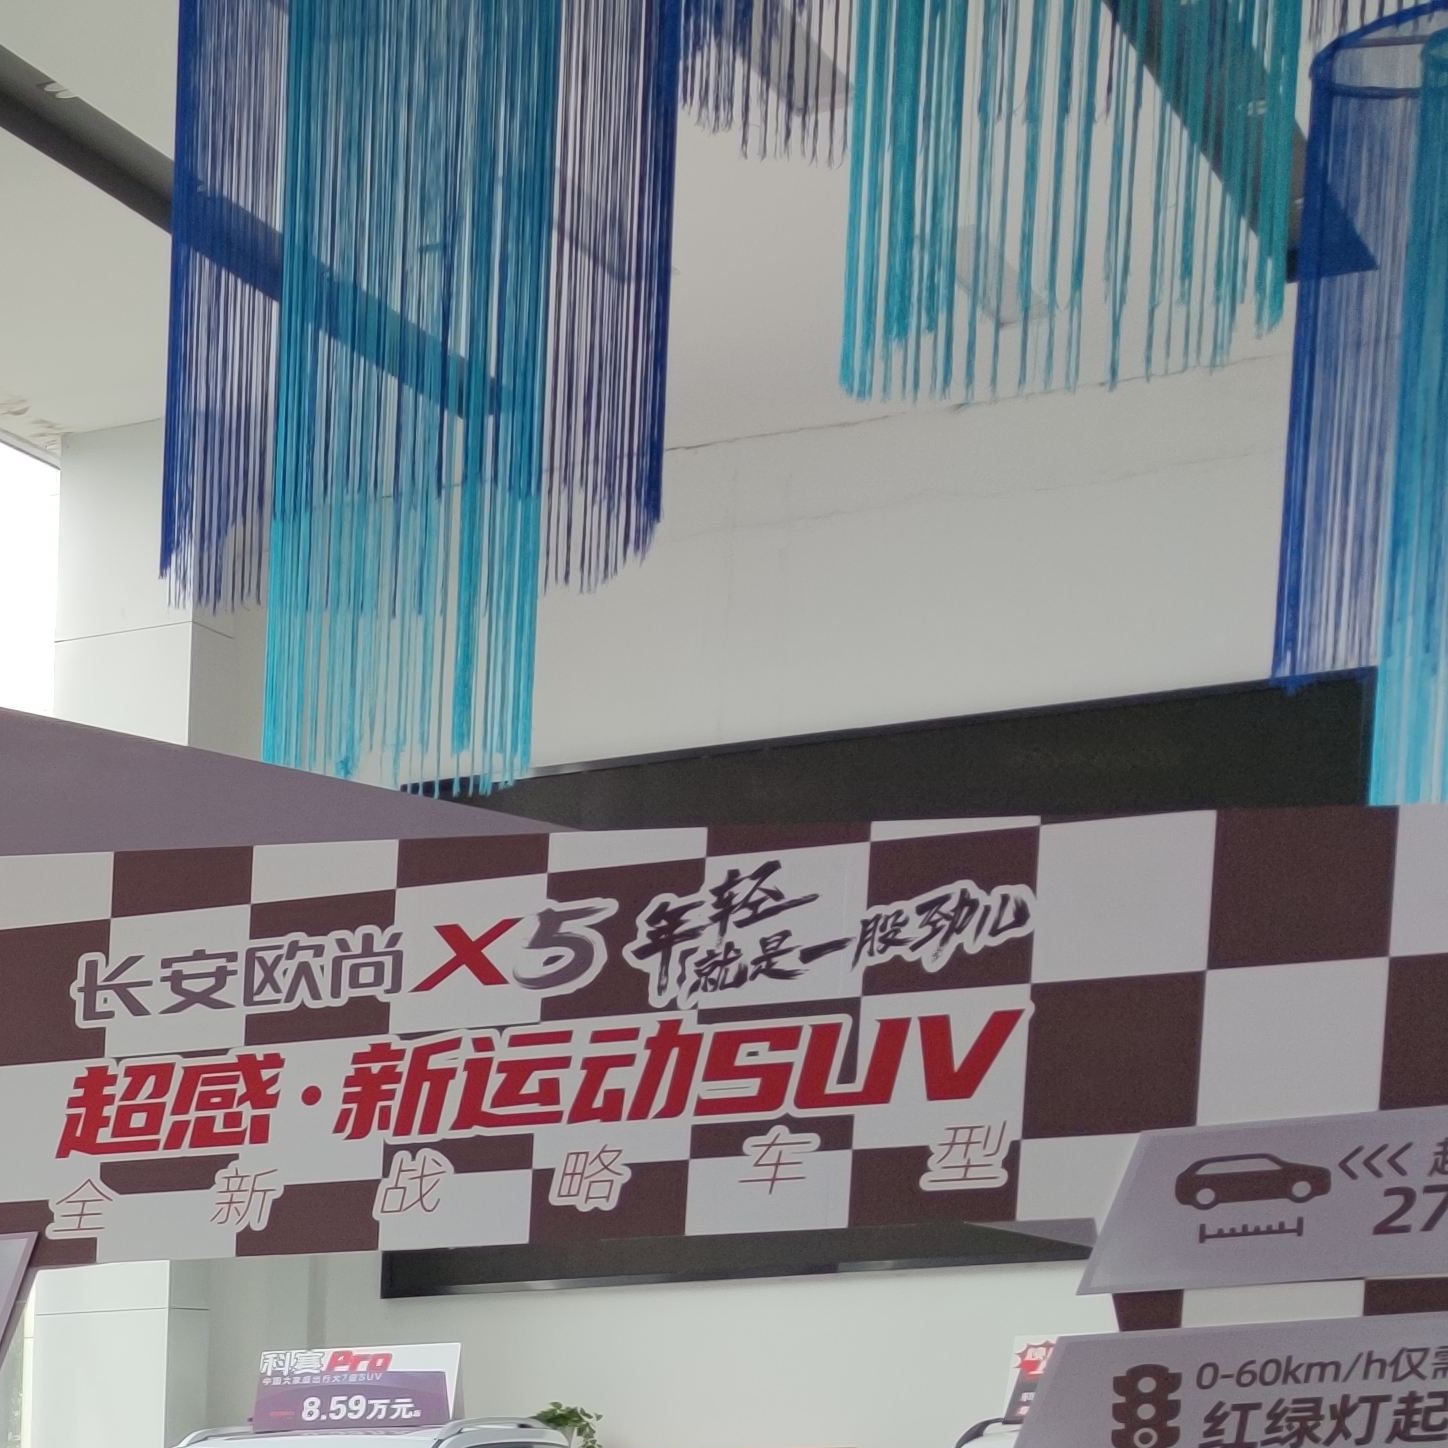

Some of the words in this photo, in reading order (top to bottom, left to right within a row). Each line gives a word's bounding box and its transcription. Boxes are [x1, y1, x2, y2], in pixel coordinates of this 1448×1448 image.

[77, 899, 603, 1023] 长安欧尚X5
[634, 861, 1030, 1000] 年轻就是一股劲儿
[55, 1117, 1005, 1232] 全新战略车型
